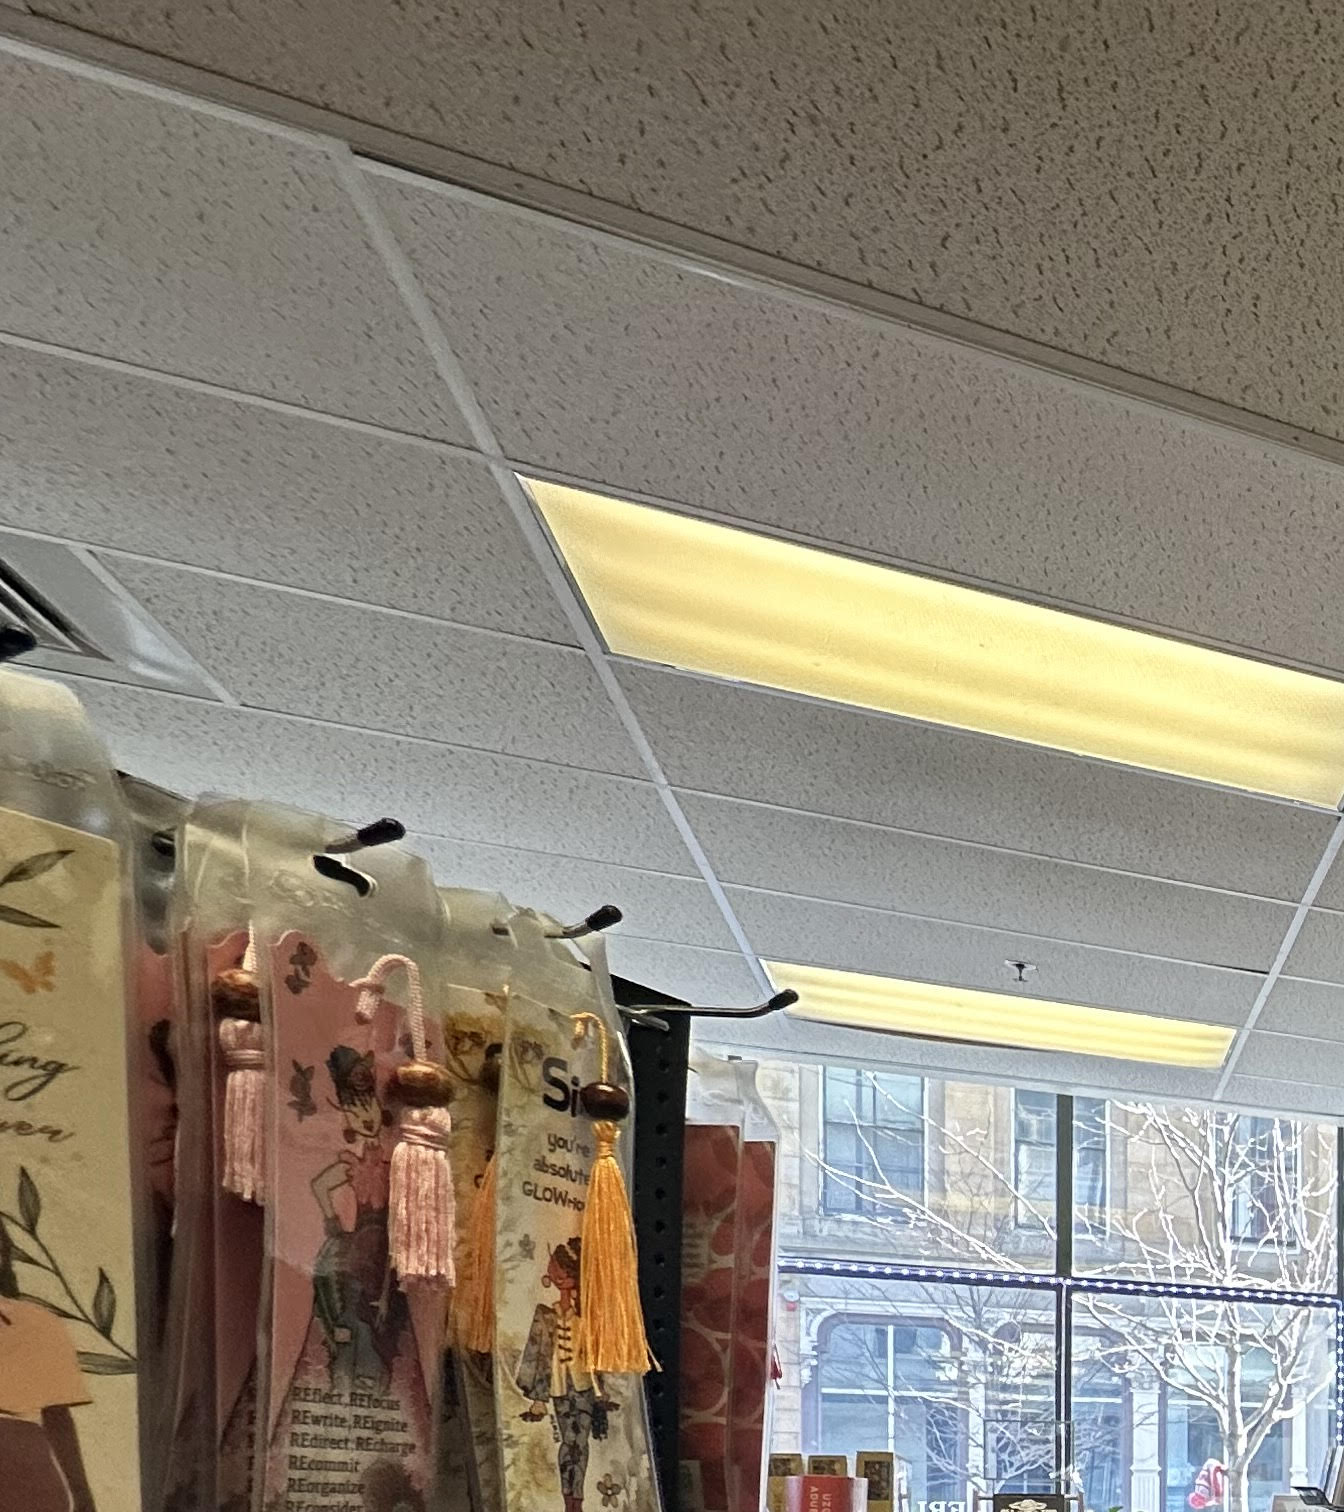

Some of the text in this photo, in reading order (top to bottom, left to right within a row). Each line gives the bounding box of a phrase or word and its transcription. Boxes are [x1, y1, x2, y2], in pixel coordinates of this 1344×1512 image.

[542, 1056, 583, 1118] Si
[547, 1132, 591, 1158] you're
[287, 1477, 365, 1496] REorganize
